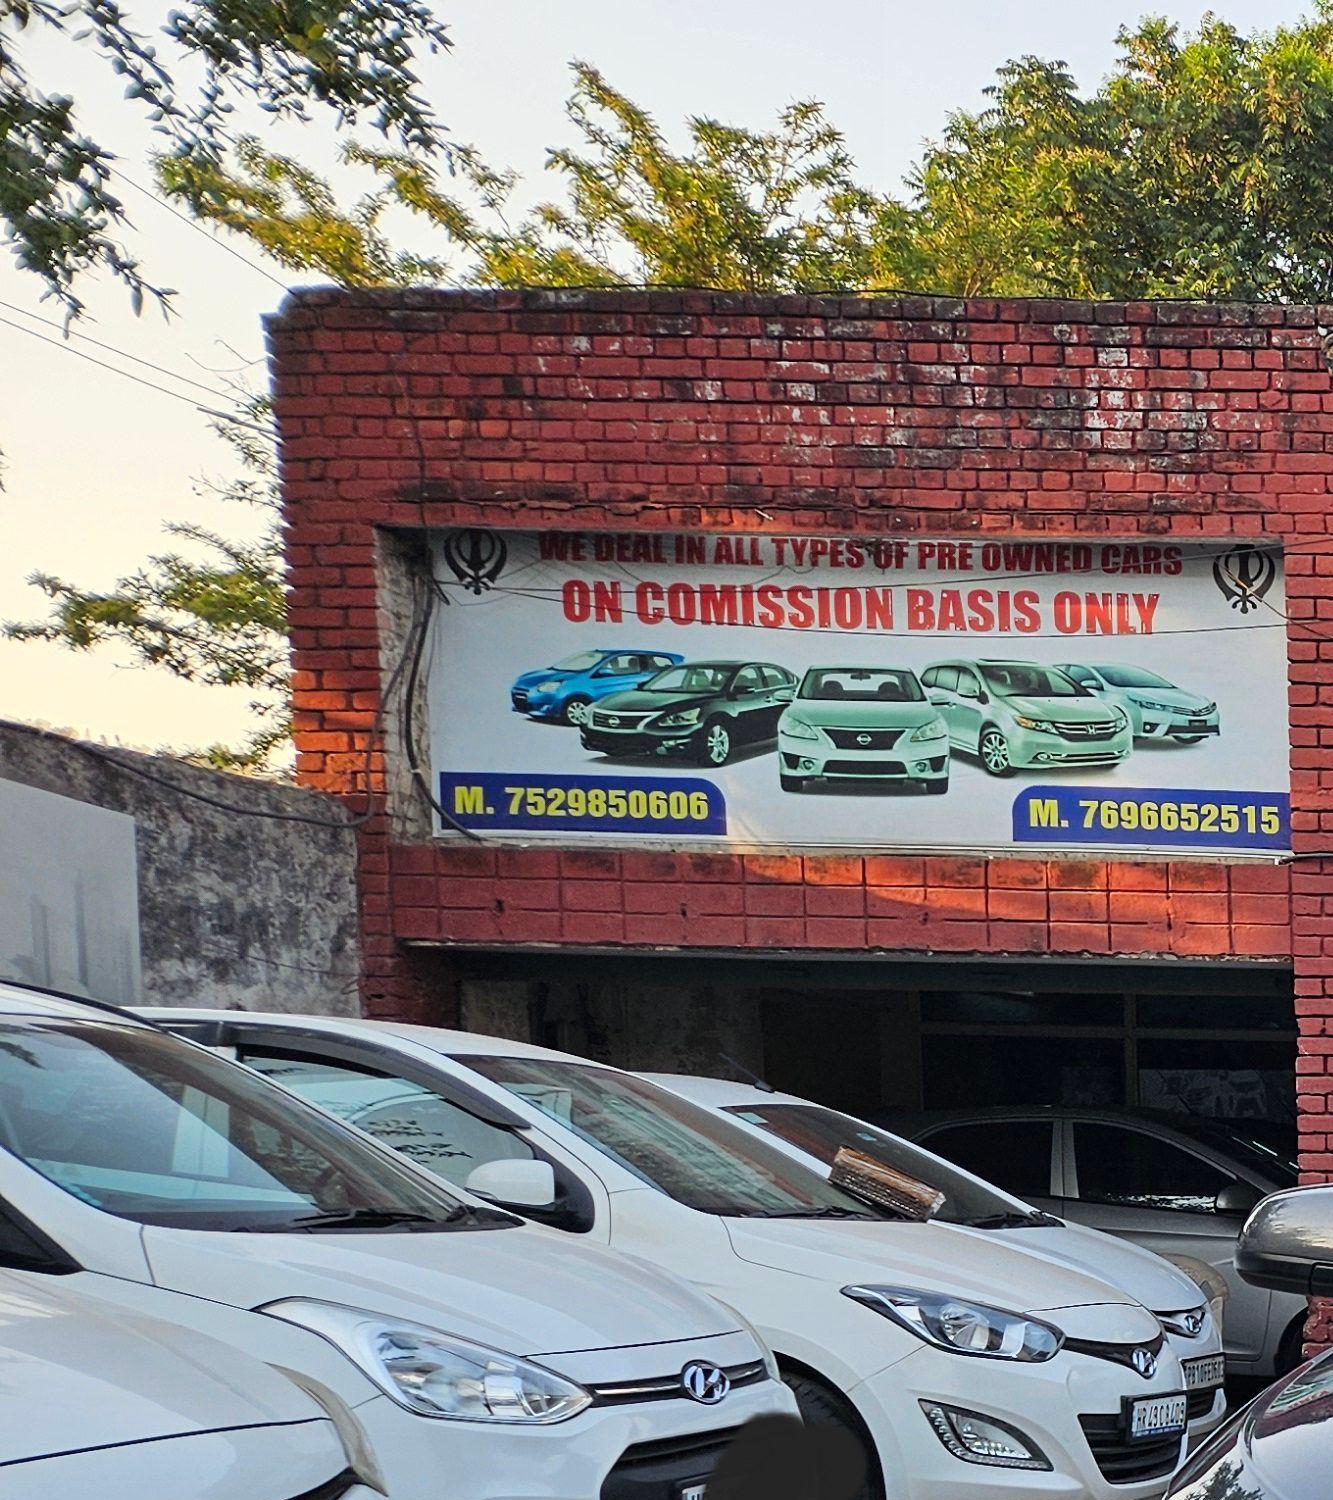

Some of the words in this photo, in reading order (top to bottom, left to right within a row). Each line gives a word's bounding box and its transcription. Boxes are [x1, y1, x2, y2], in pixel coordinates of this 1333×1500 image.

[539, 531, 587, 561] WE
[594, 532, 667, 563] DEAL
[675, 535, 706, 565] IN
[714, 536, 763, 566] ALL
[771, 537, 865, 568] TYPES
[875, 541, 909, 570] OF
[917, 542, 973, 571] PRE
[982, 543, 1092, 574] OWNED
[1102, 545, 1183, 575] CARS
[562, 579, 622, 623] ON
[635, 582, 893, 629] COMISSION
[907, 589, 1041, 633] BASIS
[1053, 591, 1160, 634] ONLY
[454, 786, 494, 815] M.
[505, 787, 709, 820] 7529850606
[1029, 799, 1069, 827] M.
[1079, 800, 1280, 834] 7696652515
